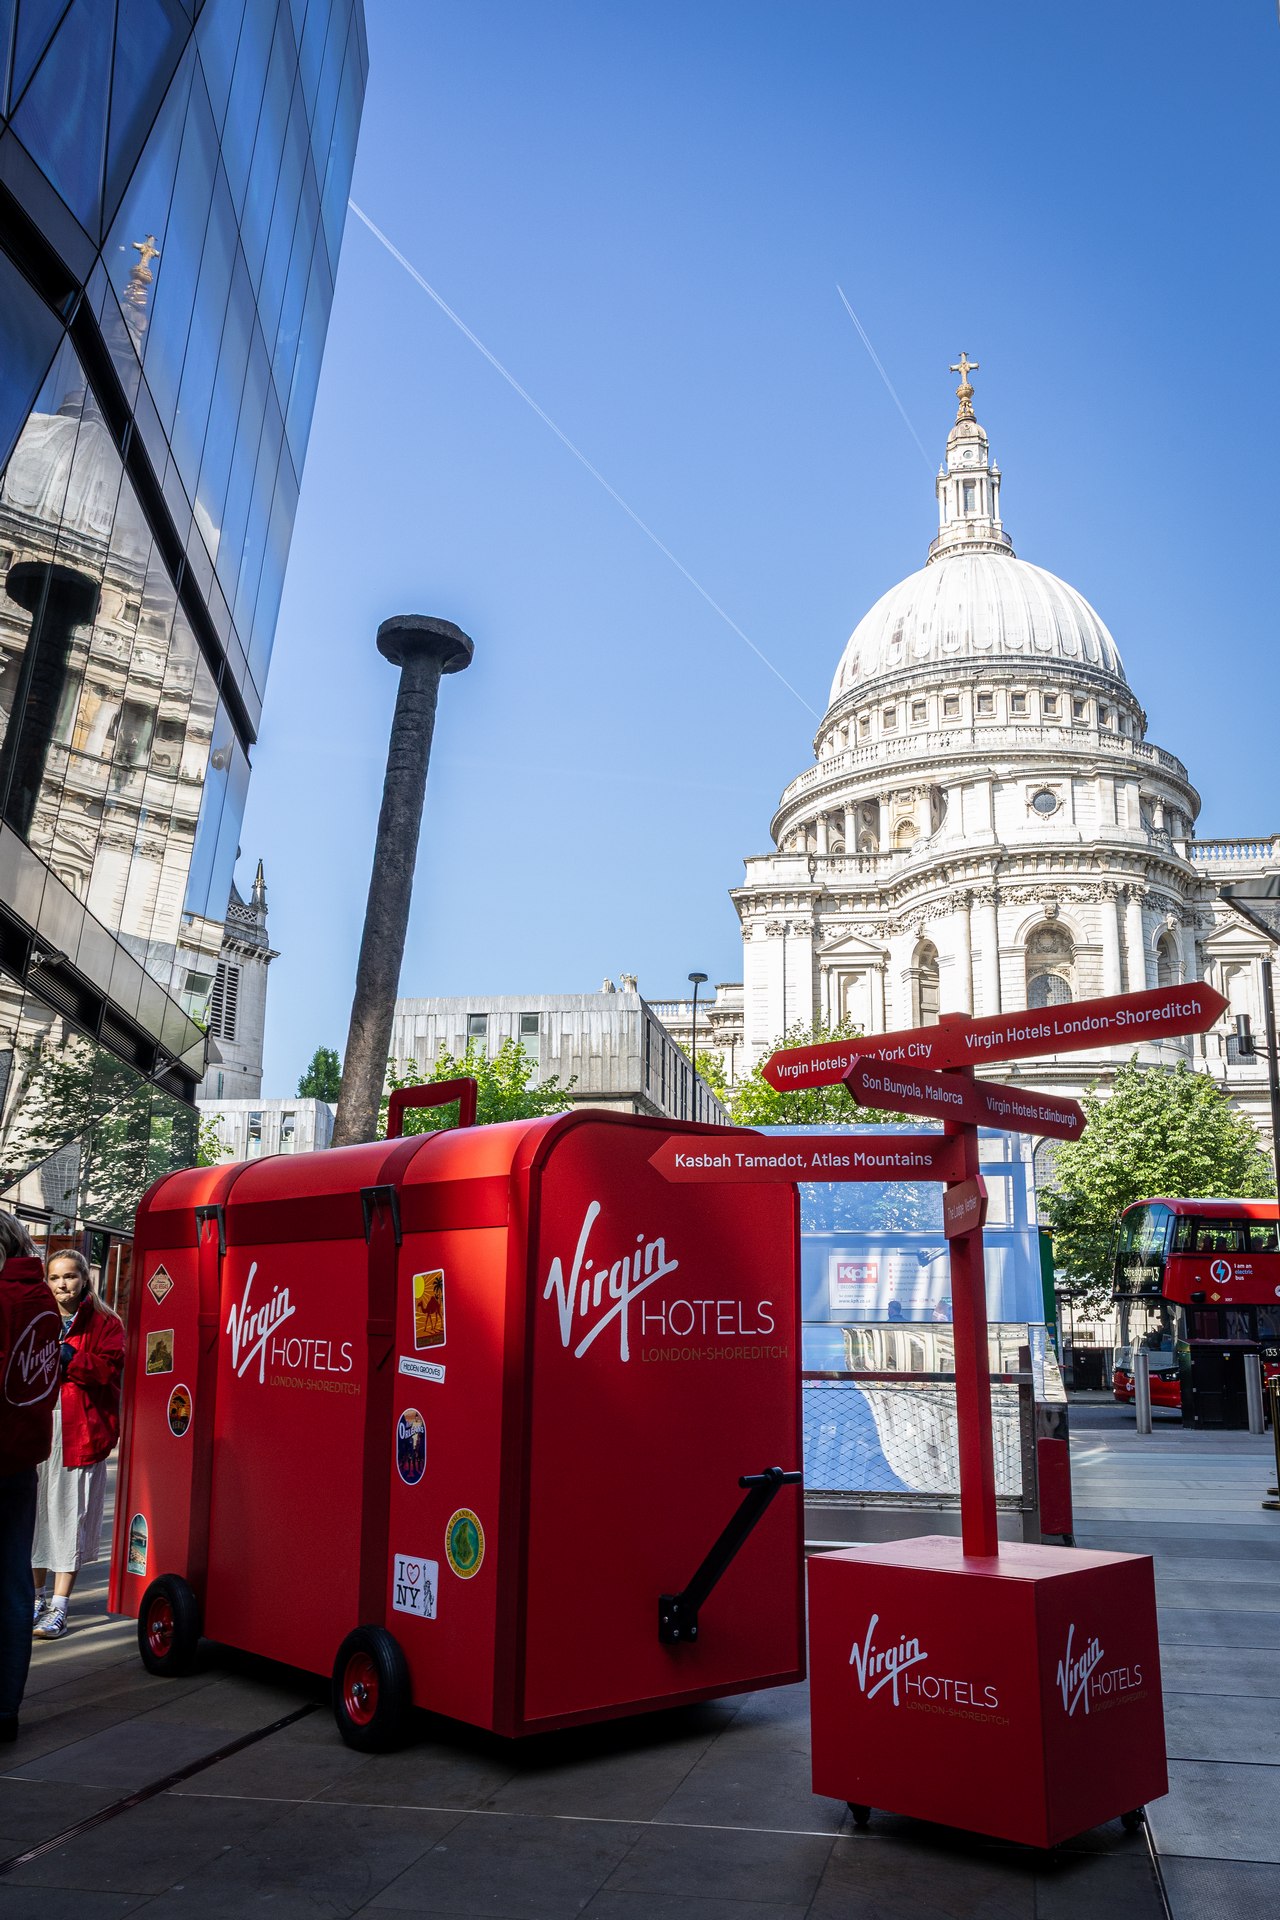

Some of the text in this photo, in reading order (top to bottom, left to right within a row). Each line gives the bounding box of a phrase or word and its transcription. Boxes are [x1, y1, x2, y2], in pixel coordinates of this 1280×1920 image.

[965, 999, 1201, 1049] Virgin Hotels London-Shoreditch
[776, 1063, 809, 1079] Virgin
[811, 1055, 847, 1072] Hotels
[878, 1046, 905, 1060] York
[907, 1043, 933, 1058] City
[862, 1073, 963, 1105] Son Bunyola, Mallorca
[986, 1096, 1078, 1128] Virgin Hotels Edinburgh
[674, 1151, 933, 1169] Kasbah Tamadot, Atlas Mountains
[543, 1200, 679, 1363] Virgin
[226, 1261, 296, 1385] Virgin
[641, 1299, 775, 1336] HOTELS
[17, 1329, 59, 1385] Virgin
[271, 1337, 353, 1373] HOTELS
[641, 1345, 788, 1363] LONDON-SHOREDITCH
[1265, 1348, 1278, 1357] 133
[270, 1375, 361, 1395] LONDON-SHOREDITCH
[403, 1362, 441, 1377] HIDDEN GROOVES
[398, 1561, 406, 1582] I
[396, 1584, 421, 1609] NY
[849, 1613, 928, 1706] Virgin
[1055, 1623, 1104, 1717] Virgin
[904, 1672, 999, 1709] HOTELS
[1091, 1664, 1143, 1697] HOTELS
[905, 1700, 1010, 1727] LONDON-SHOREDITCH
